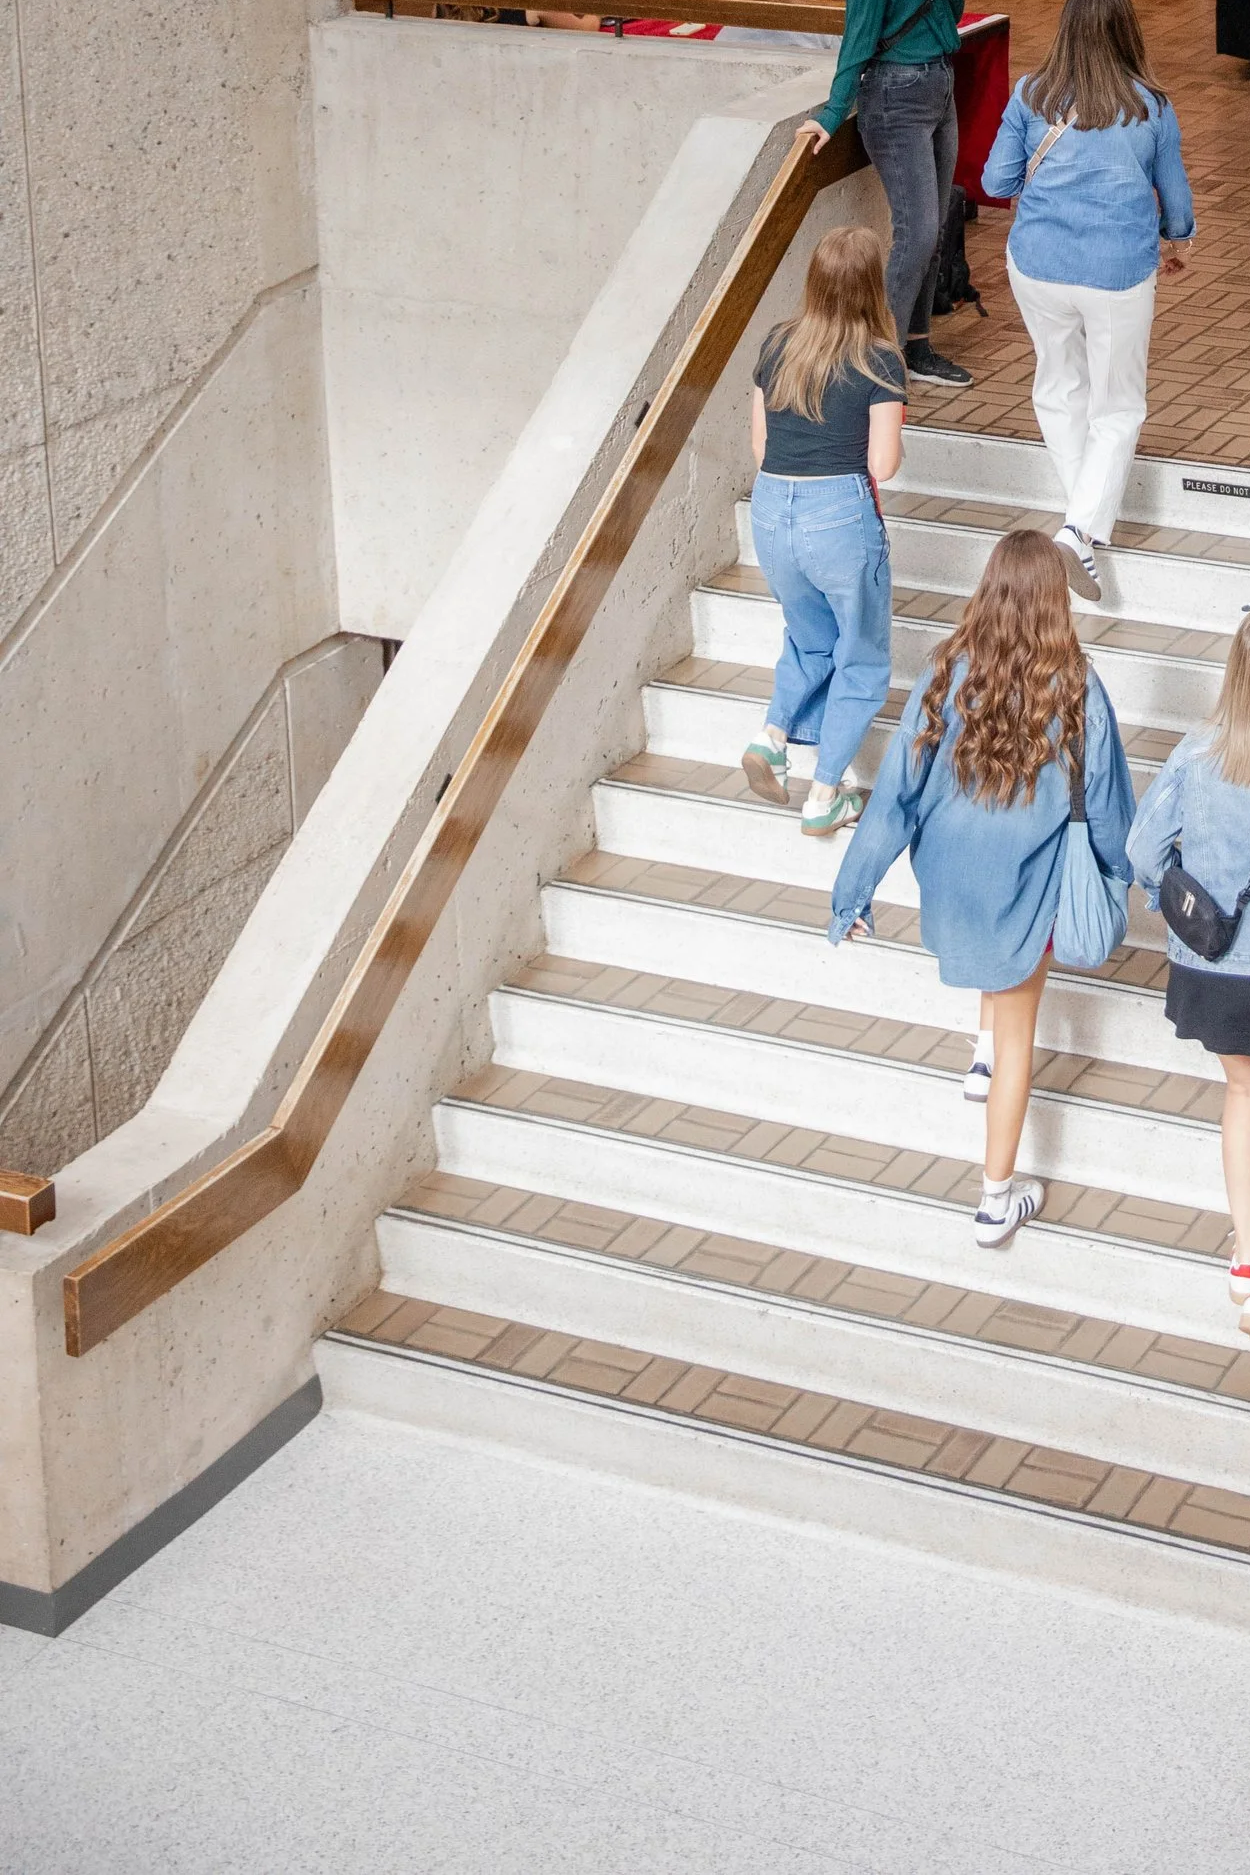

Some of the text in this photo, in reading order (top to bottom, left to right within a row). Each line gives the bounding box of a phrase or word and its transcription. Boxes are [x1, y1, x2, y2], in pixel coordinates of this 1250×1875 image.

[1186, 480, 1218, 493] PLEASE
[1220, 485, 1231, 494] DO
[1233, 487, 1249, 496] NOT
